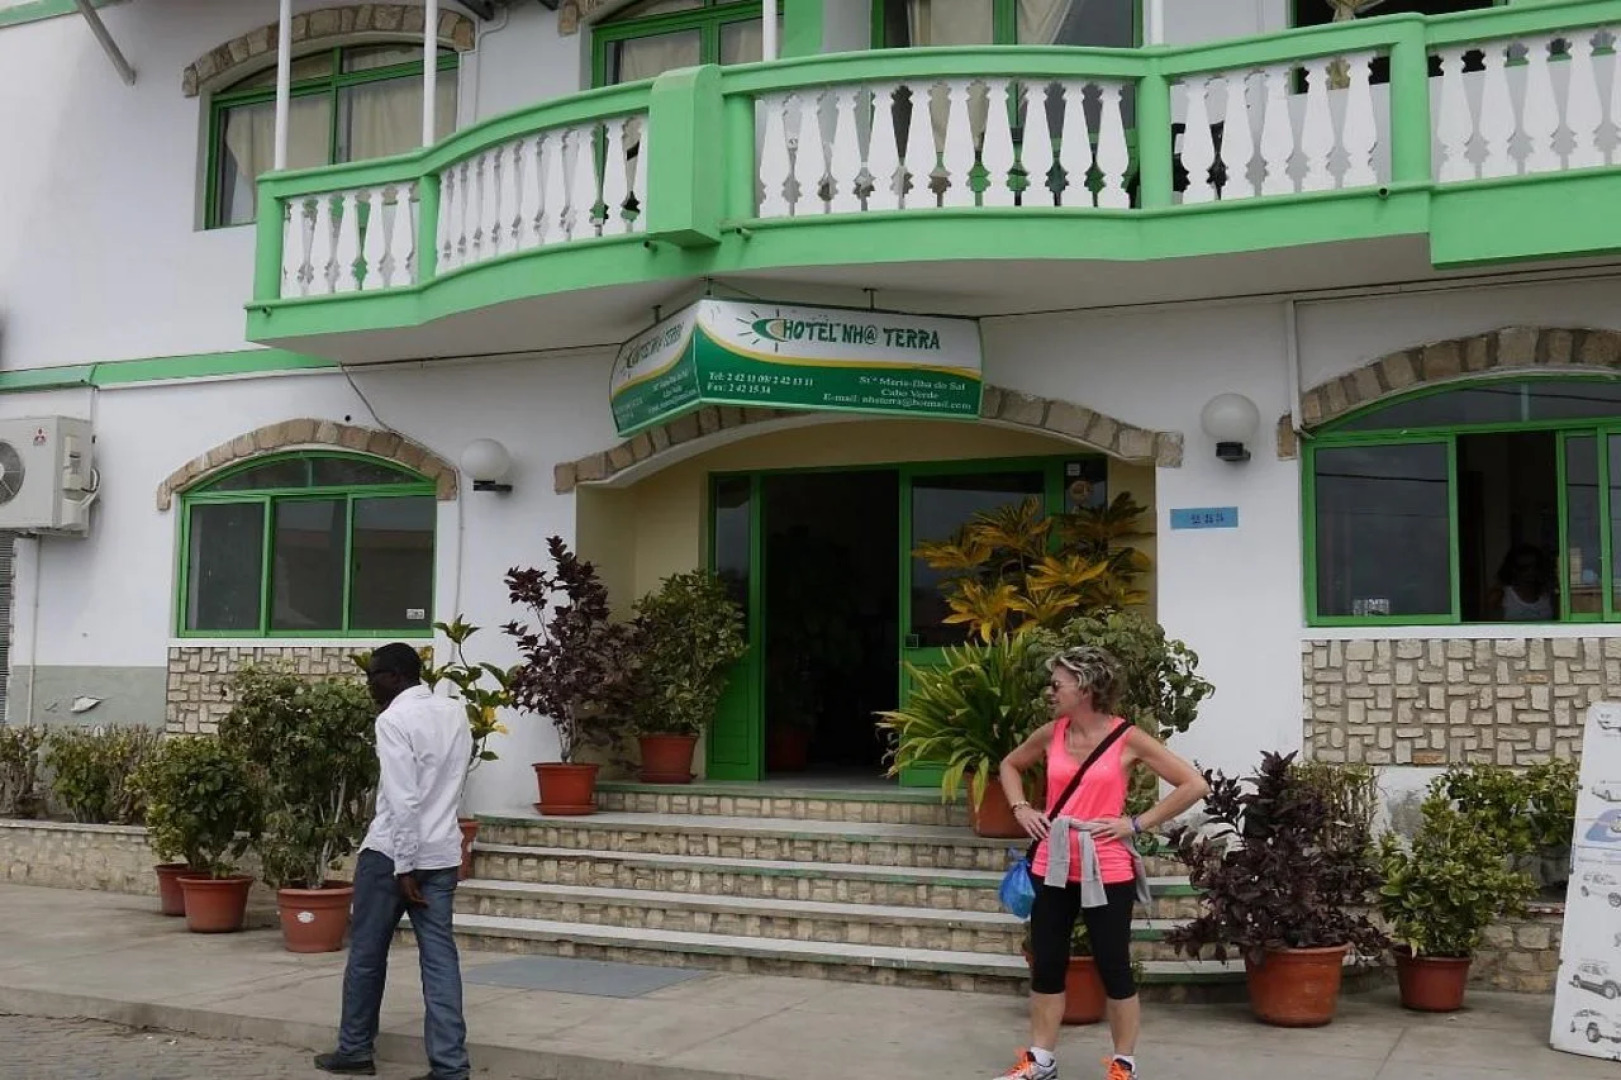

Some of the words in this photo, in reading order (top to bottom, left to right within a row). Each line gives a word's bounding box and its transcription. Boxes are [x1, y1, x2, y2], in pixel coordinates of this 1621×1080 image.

[883, 327, 941, 350] TERRA
[949, 381, 966, 391] Sal
[880, 388, 908, 398] Cabo
[909, 389, 940, 400] Verde
